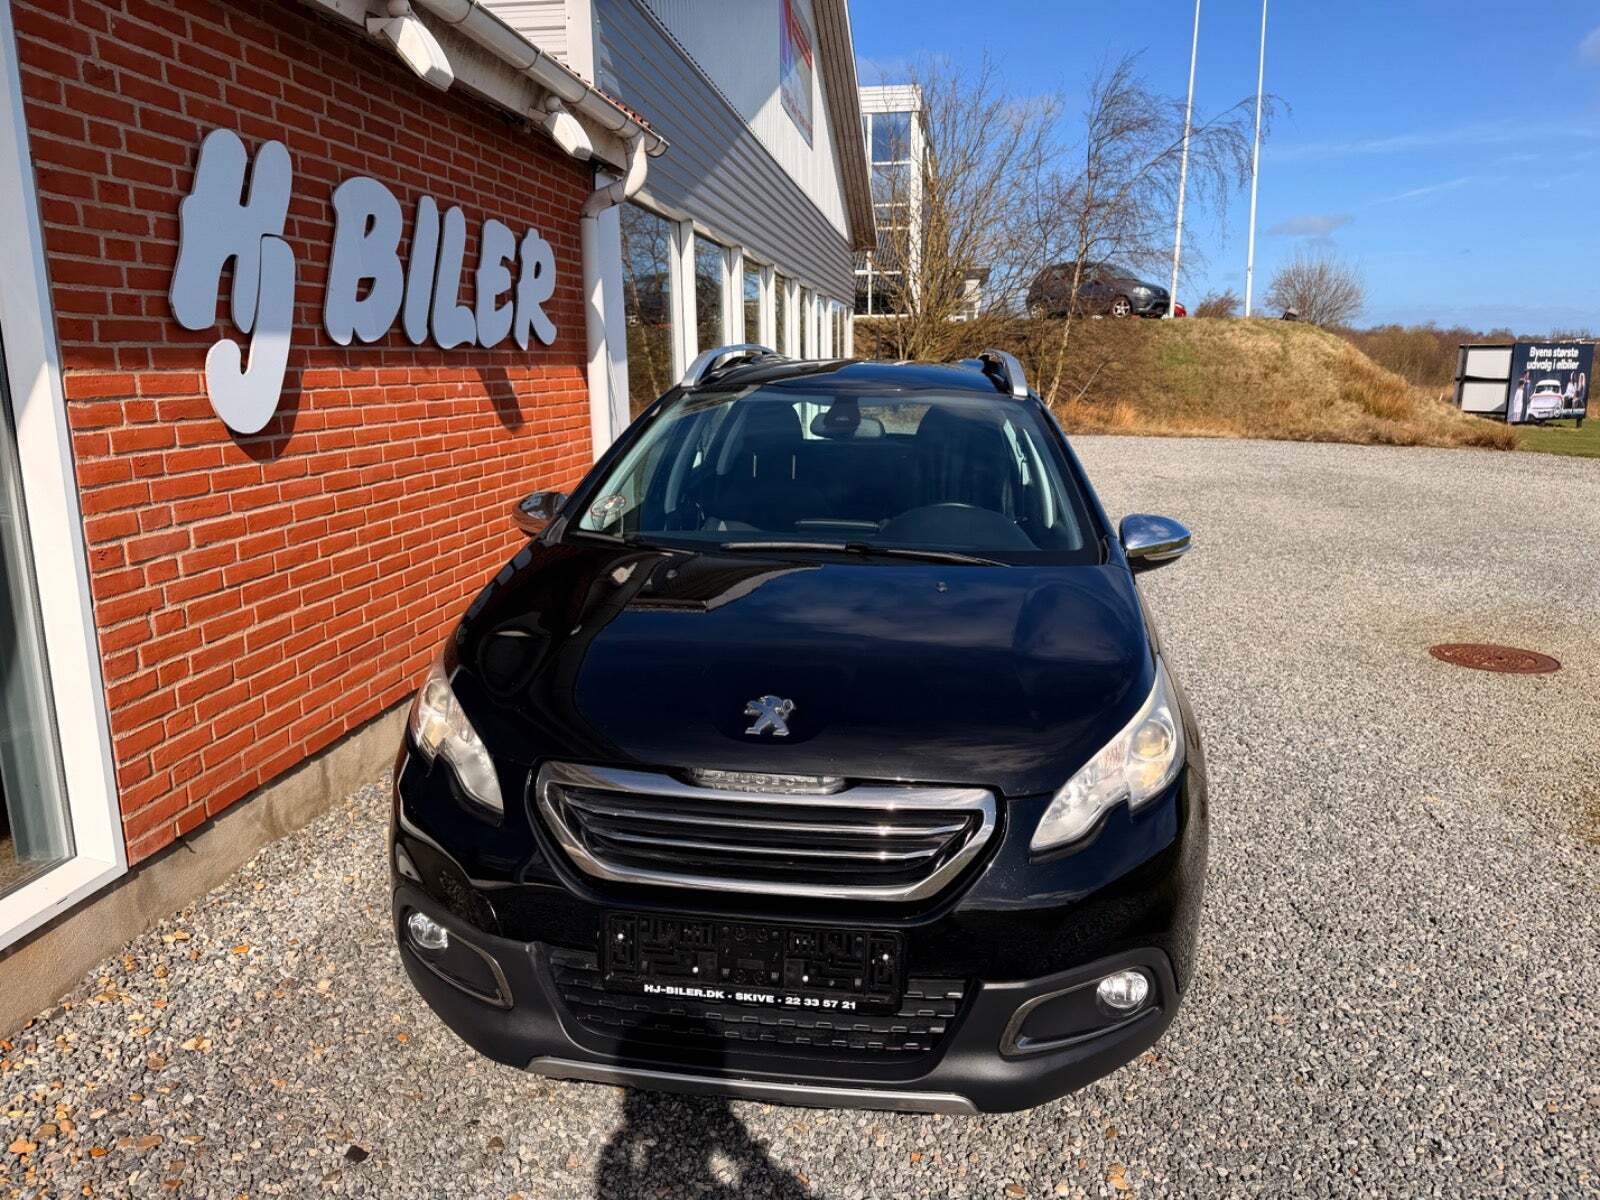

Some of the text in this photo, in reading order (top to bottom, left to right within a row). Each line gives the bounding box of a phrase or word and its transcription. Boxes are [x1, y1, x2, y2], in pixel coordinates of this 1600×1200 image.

[323, 176, 558, 351] BILER
[1529, 346, 1553, 362] Byens
[643, 983, 857, 1010] HJ-BILER.DK SKIVE 22 33 57 21
